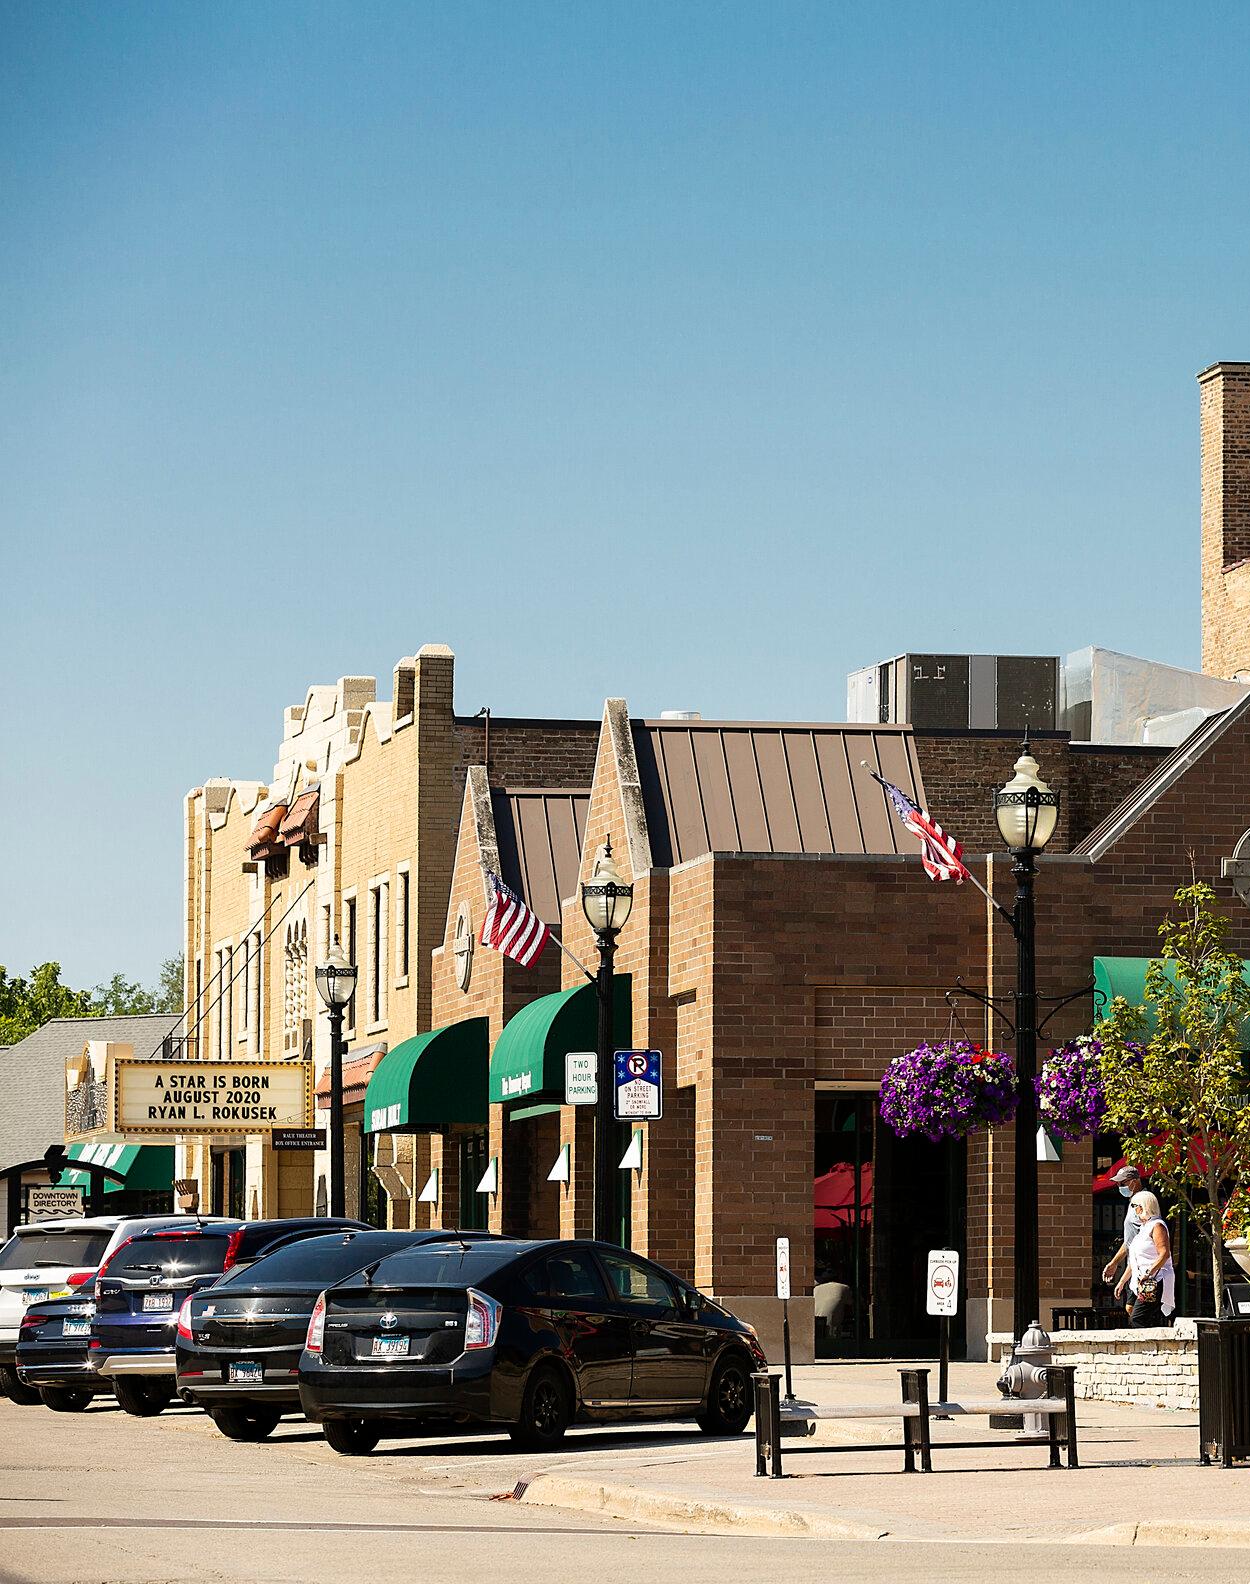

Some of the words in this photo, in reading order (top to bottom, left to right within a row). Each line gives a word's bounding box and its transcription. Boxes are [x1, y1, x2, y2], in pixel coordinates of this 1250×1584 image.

[573, 1060, 589, 1069] TWO
[155, 1075, 164, 1088] A
[169, 1075, 206, 1088] STAR
[213, 1075, 227, 1089] IS
[232, 1076, 270, 1089] BORN
[572, 1073, 592, 1082] HOUR
[568, 1085, 596, 1095] PARKING
[163, 1090, 219, 1104] AUGUST
[226, 1090, 261, 1104] 2020
[149, 1105, 186, 1119] RYAN
[193, 1106, 205, 1119] L.
[212, 1106, 277, 1120] ROKUSEK
[32, 1192, 78, 1200] DOWNTOWN
